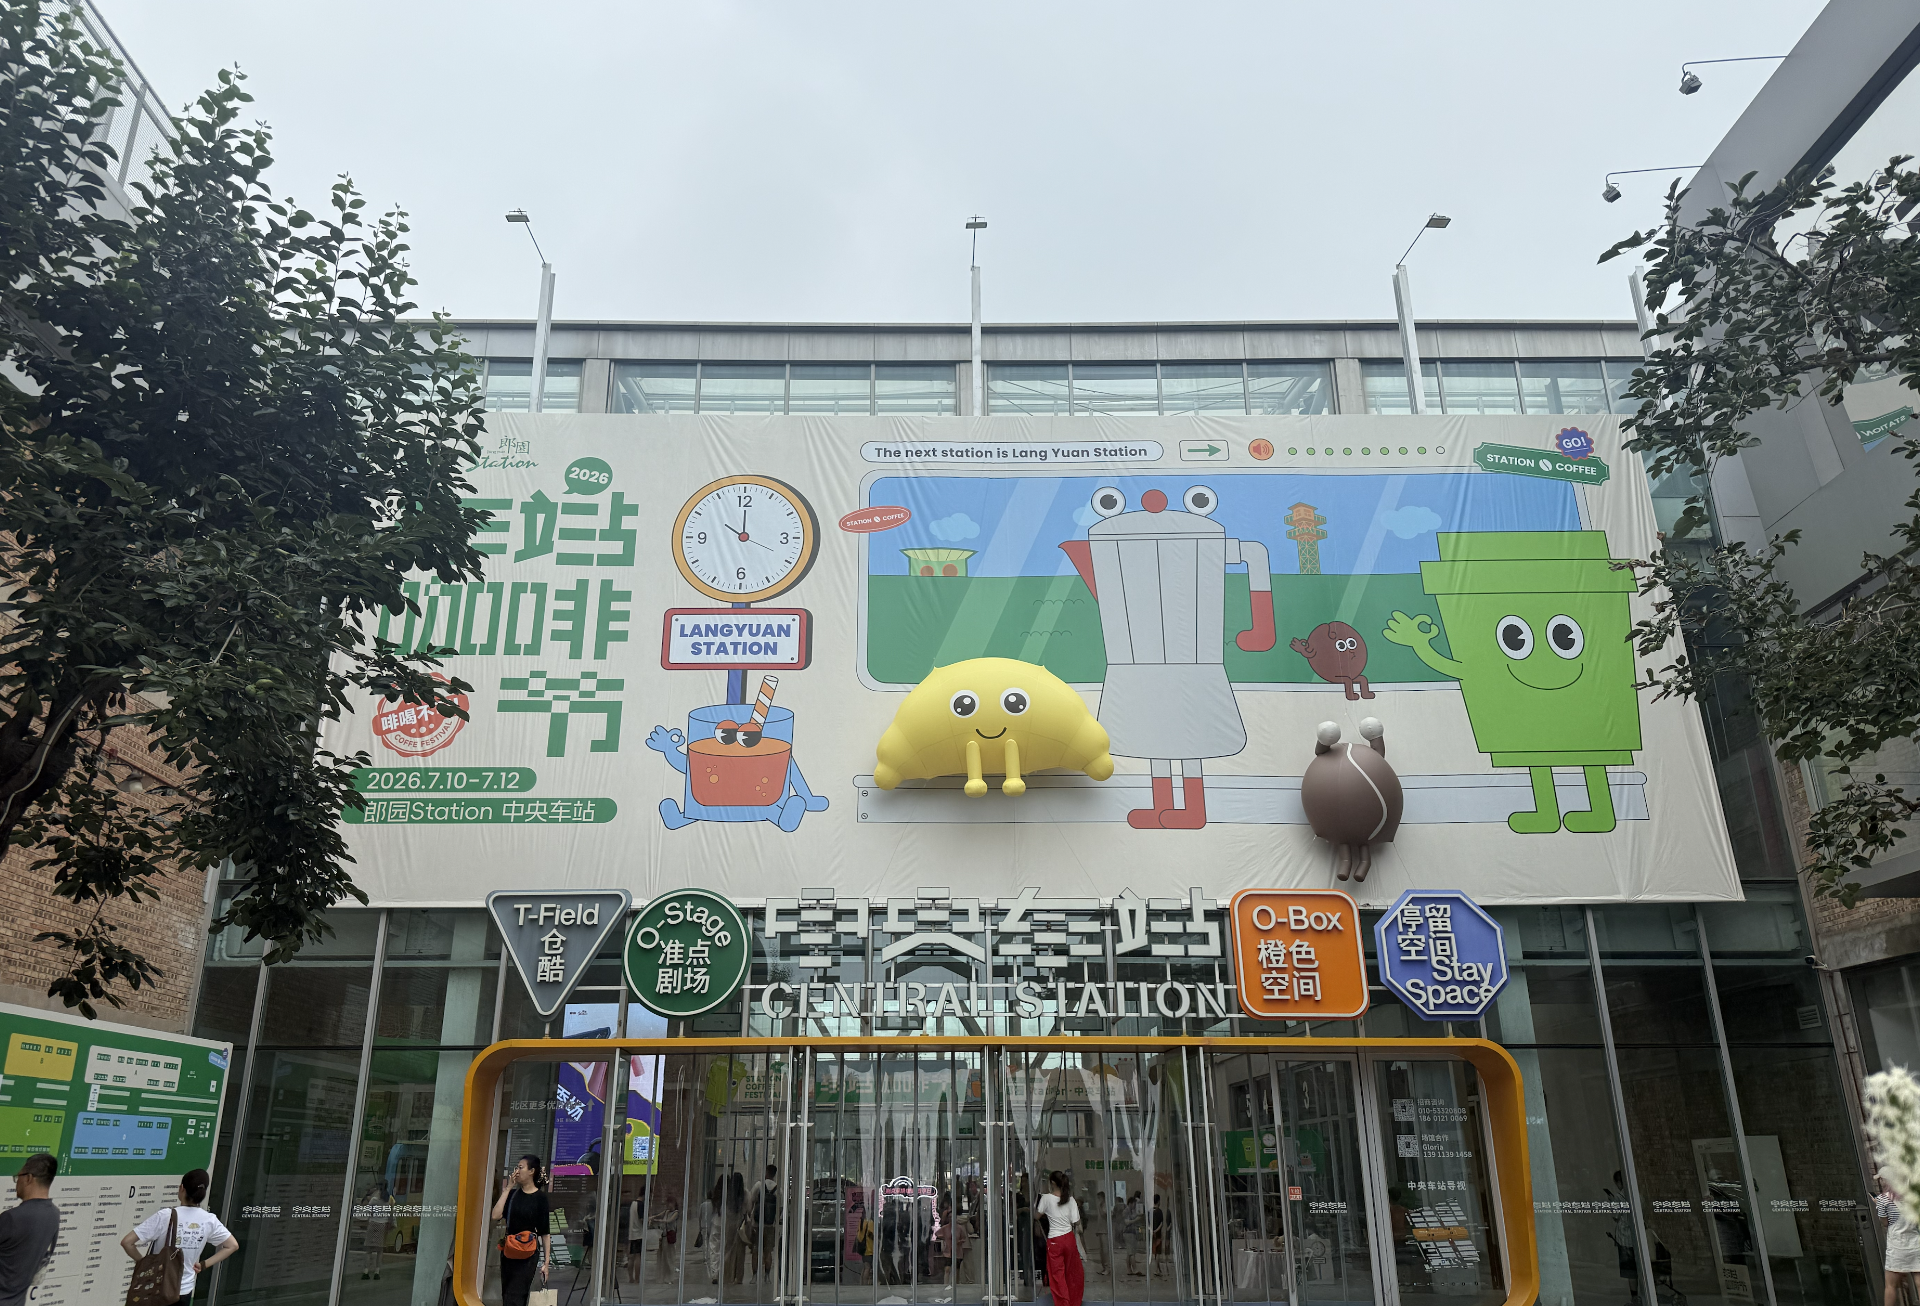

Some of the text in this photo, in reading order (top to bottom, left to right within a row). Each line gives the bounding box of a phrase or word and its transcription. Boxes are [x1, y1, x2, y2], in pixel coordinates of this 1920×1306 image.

[875, 446, 1147, 461] The next station is Lang Yuan Station
[1562, 436, 1587, 449] GO!
[465, 446, 539, 472] Station
[1486, 454, 1597, 475] STATION COFFEE
[568, 466, 609, 485] 2026
[737, 495, 752, 508] 12
[846, 513, 904, 527] STATION COFFEE
[697, 532, 707, 545] 9
[779, 532, 789, 545] 3
[736, 567, 746, 580] 6
[679, 623, 791, 638] LANGYUAN
[690, 642, 778, 656] STATION
[497, 670, 625, 757] 节
[394, 720, 453, 748] COFFE FESTIVAL
[366, 771, 521, 790] 2026.7.10-7.12
[363, 800, 596, 823] 郎园Station 中央车站
[513, 903, 599, 927] T-Field
[635, 900, 733, 951] O-Stage
[1251, 904, 1344, 932] O-Box
[1397, 903, 1452, 932] 停留
[764, 886, 1222, 968] 中央车站
[657, 938, 712, 967] 准点
[1256, 938, 1319, 970] 橙色
[1397, 932, 1458, 963] 空间
[654, 965, 711, 996] 剧场
[1431, 955, 1493, 987] Stay
[1262, 970, 1322, 1002] 空间
[1405, 976, 1494, 1009] Space
[761, 981, 1228, 1020] CENTRAL STATION
[1422, 1143, 1443, 1151] Gloria
[129, 1185, 136, 1199] D
[1407, 1180, 1467, 1191] 中央车站导视
[29, 1286, 38, 1300] C
